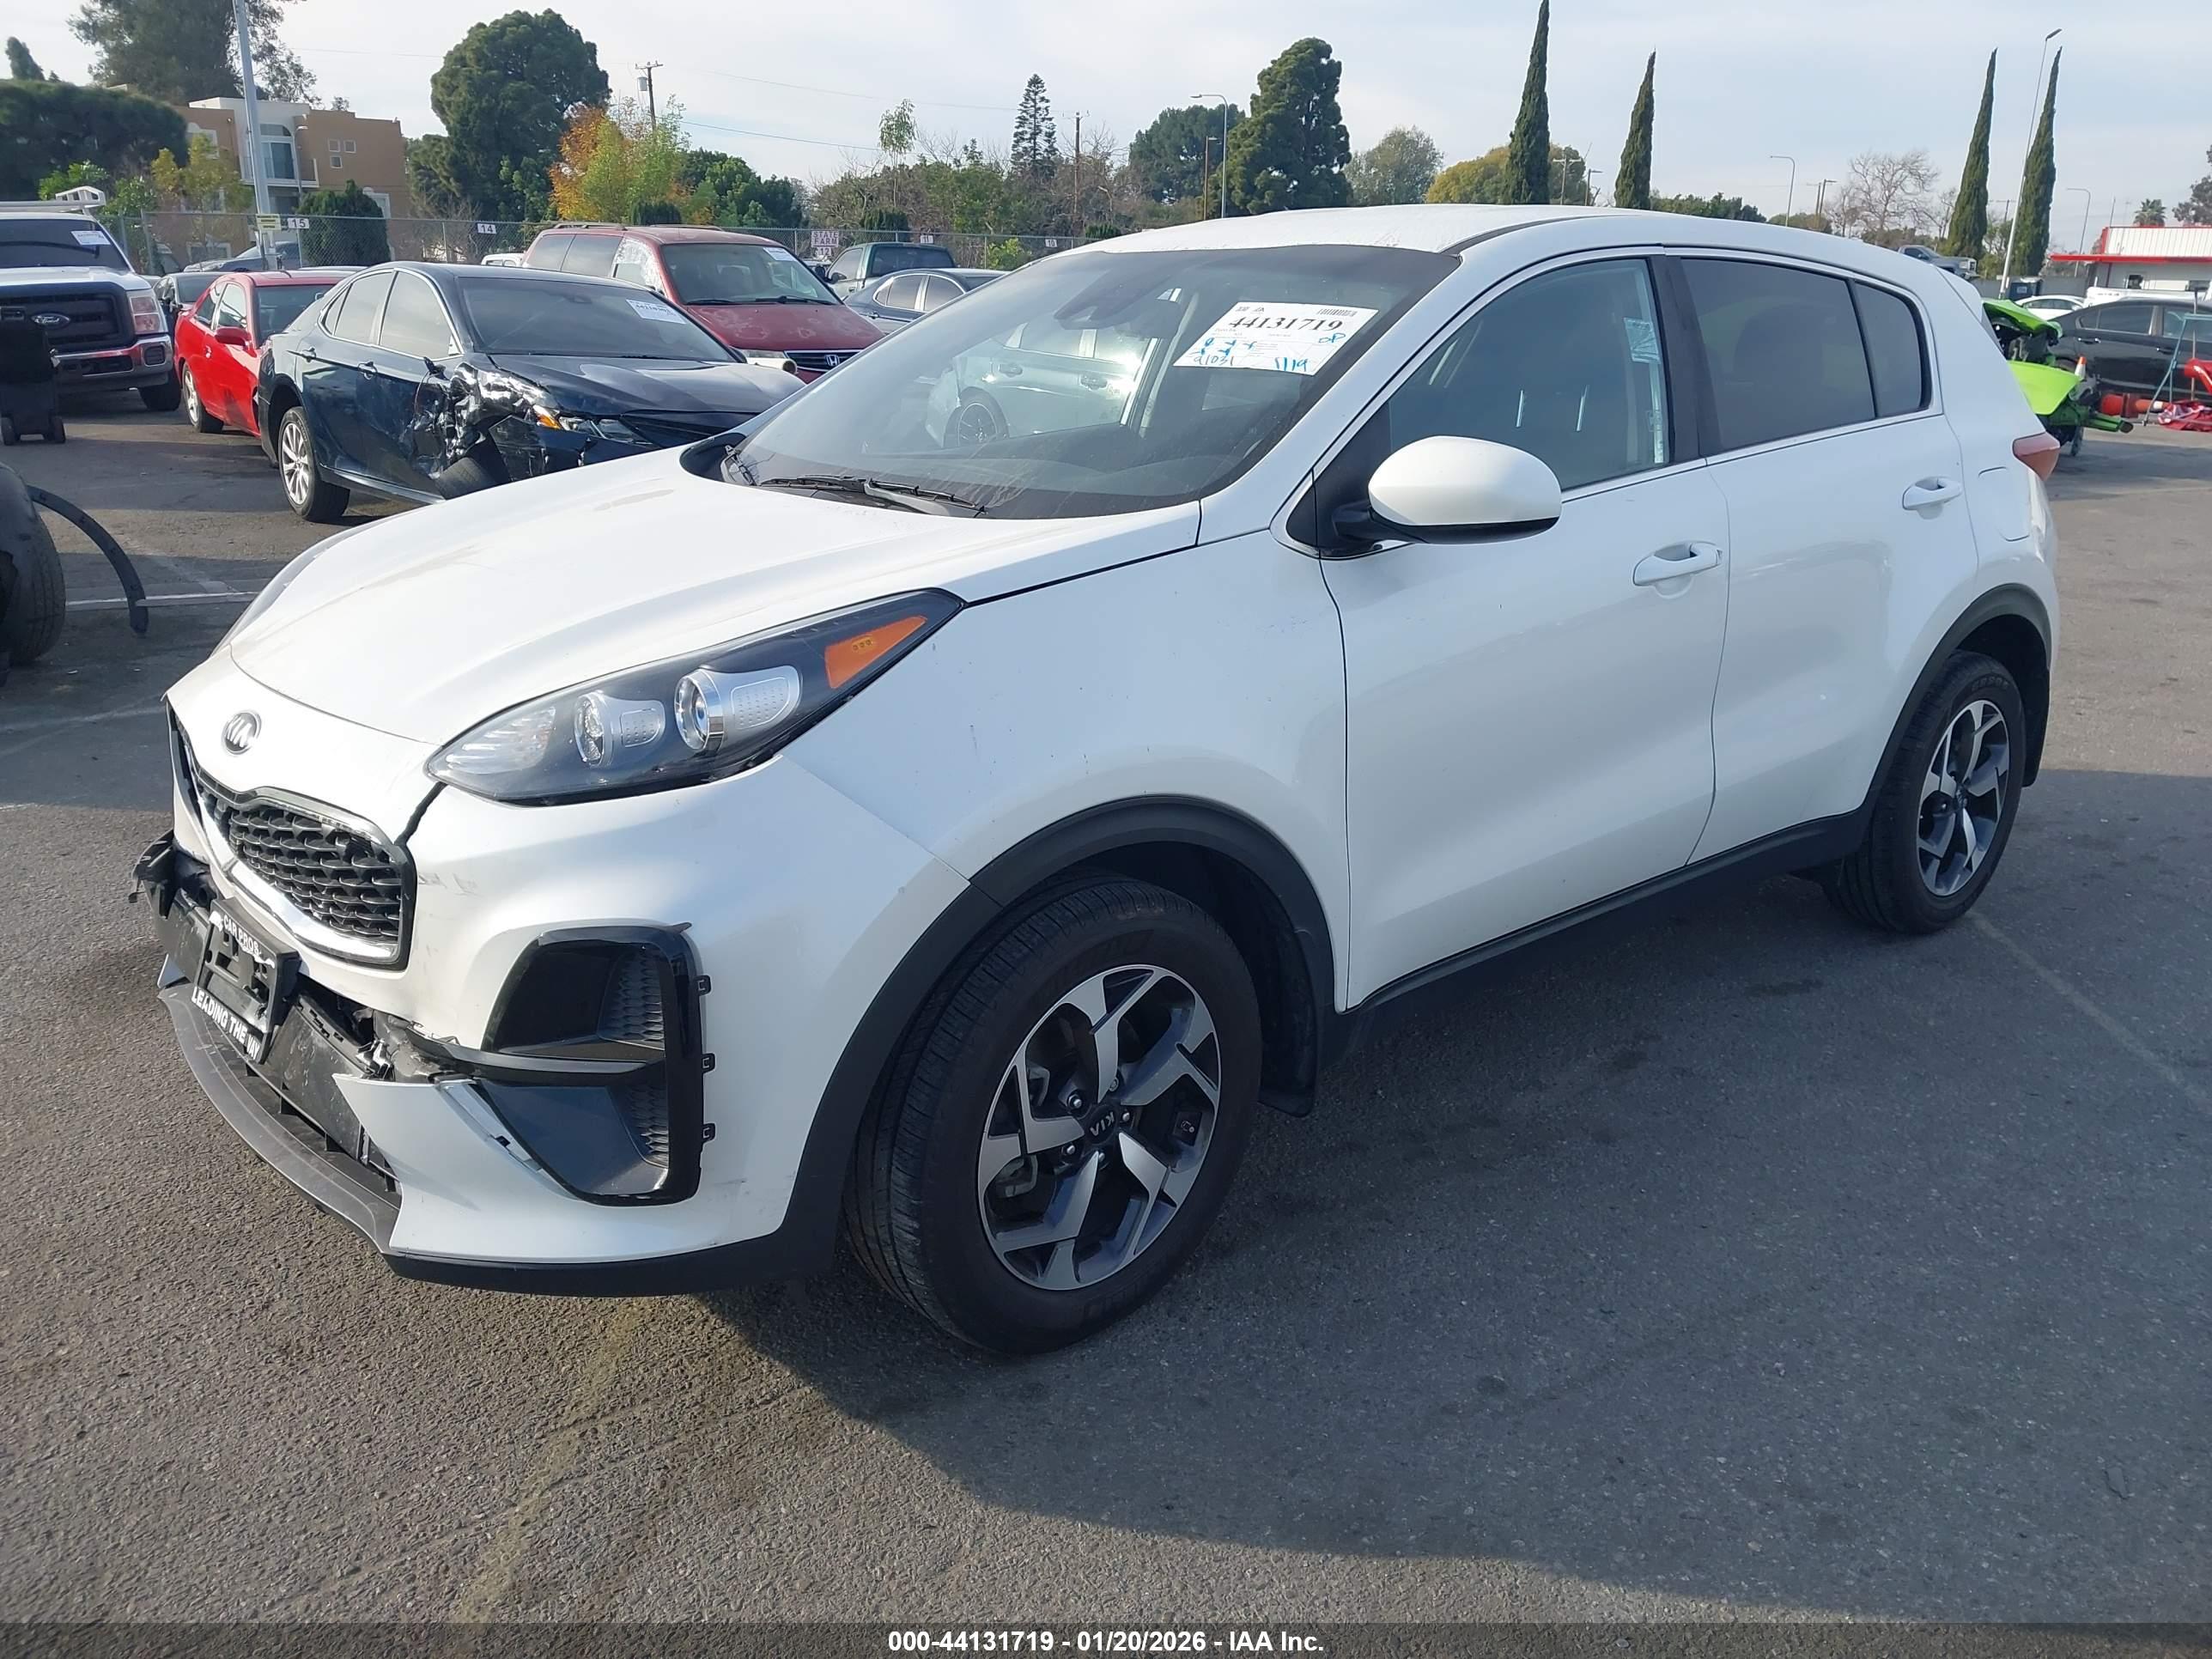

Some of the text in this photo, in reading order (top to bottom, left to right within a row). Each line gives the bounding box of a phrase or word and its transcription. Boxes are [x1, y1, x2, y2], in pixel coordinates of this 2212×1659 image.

[292, 218, 306, 228] 15
[481, 224, 494, 233] 14
[1229, 317, 1343, 331] 44131719
[224, 914, 259, 956] CAR PROS
[191, 985, 228, 1030] LEADING
[228, 1015, 248, 1045] THE
